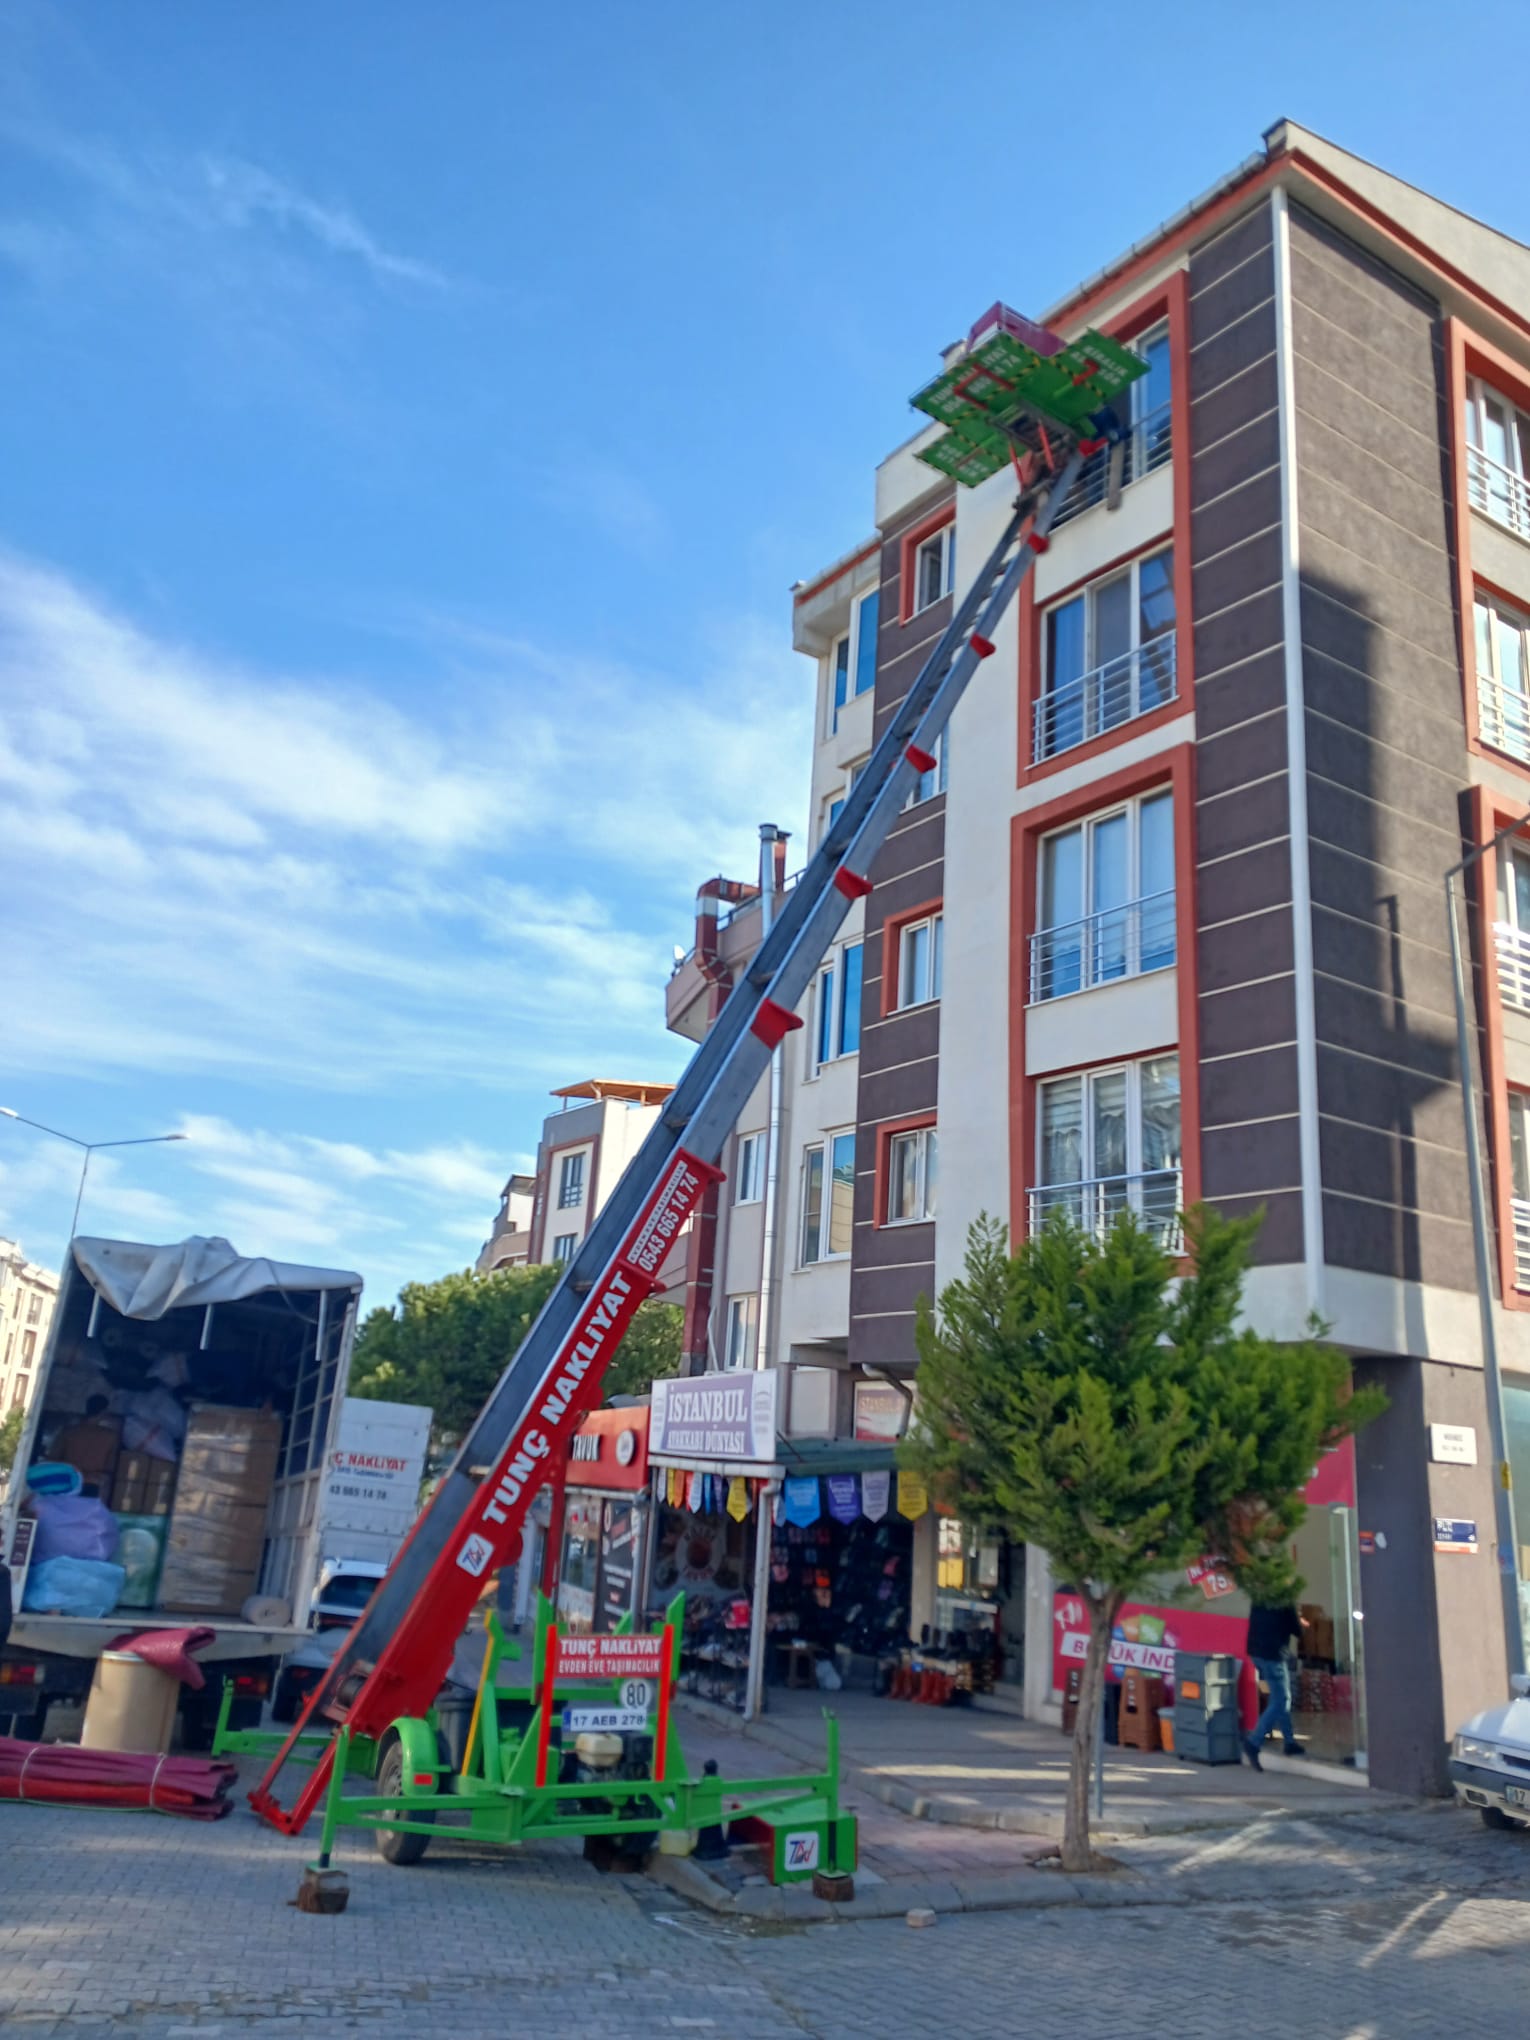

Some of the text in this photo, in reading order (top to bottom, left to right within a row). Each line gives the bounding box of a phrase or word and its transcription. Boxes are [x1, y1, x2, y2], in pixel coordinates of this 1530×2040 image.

[638, 1172, 699, 1272] 0543 665 14 74
[482, 1270, 632, 1526] TUNÇ NAKLİYAT
[667, 1384, 748, 1423] İSTANBUL
[704, 1423, 745, 1454] DÜNYASI
[560, 1638, 663, 1659] TUNÇ NAKLİYAT
[559, 1659, 660, 1676] EVDEN EVE TAŞIMACILIK
[626, 1682, 647, 1706] 80
[573, 1715, 588, 1726] 17
[591, 1715, 618, 1726] AEB
